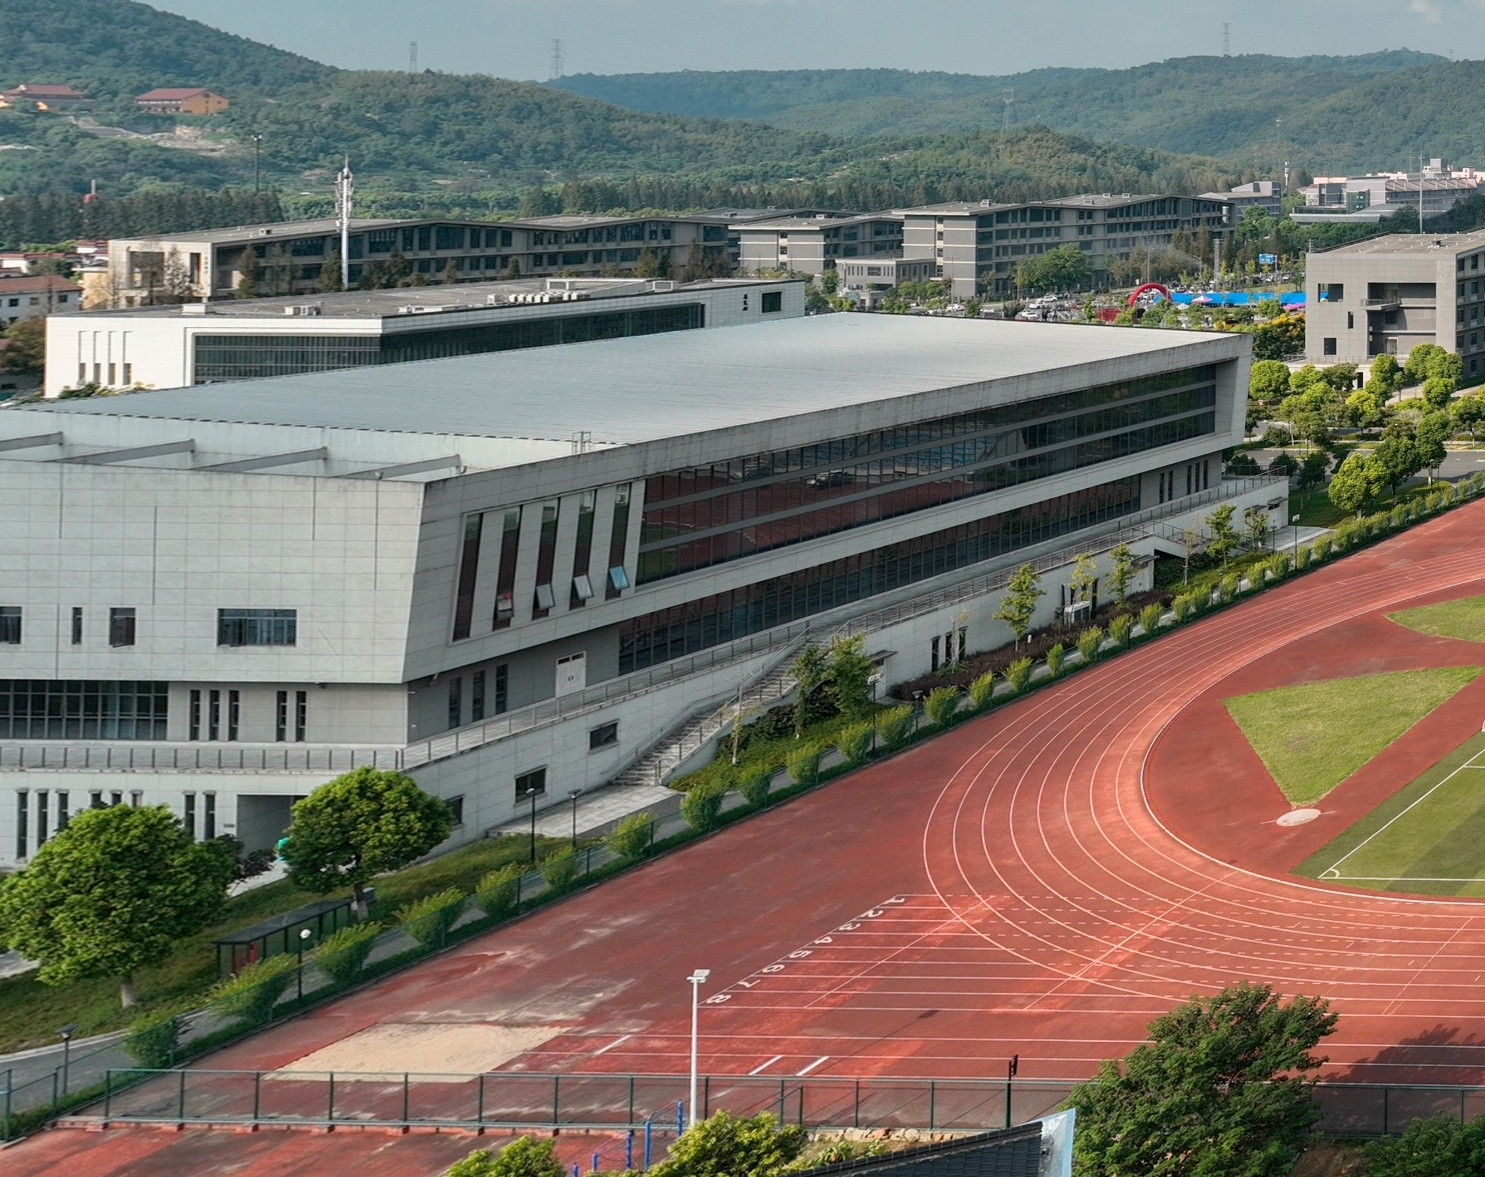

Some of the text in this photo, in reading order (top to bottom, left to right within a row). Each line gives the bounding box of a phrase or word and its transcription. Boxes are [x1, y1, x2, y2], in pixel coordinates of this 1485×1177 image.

[839, 923, 861, 931] 3
[814, 936, 833, 945] 4
[789, 950, 813, 959] 5
[762, 964, 785, 973] 6
[738, 979, 762, 989] 7
[706, 994, 733, 1004] 8
